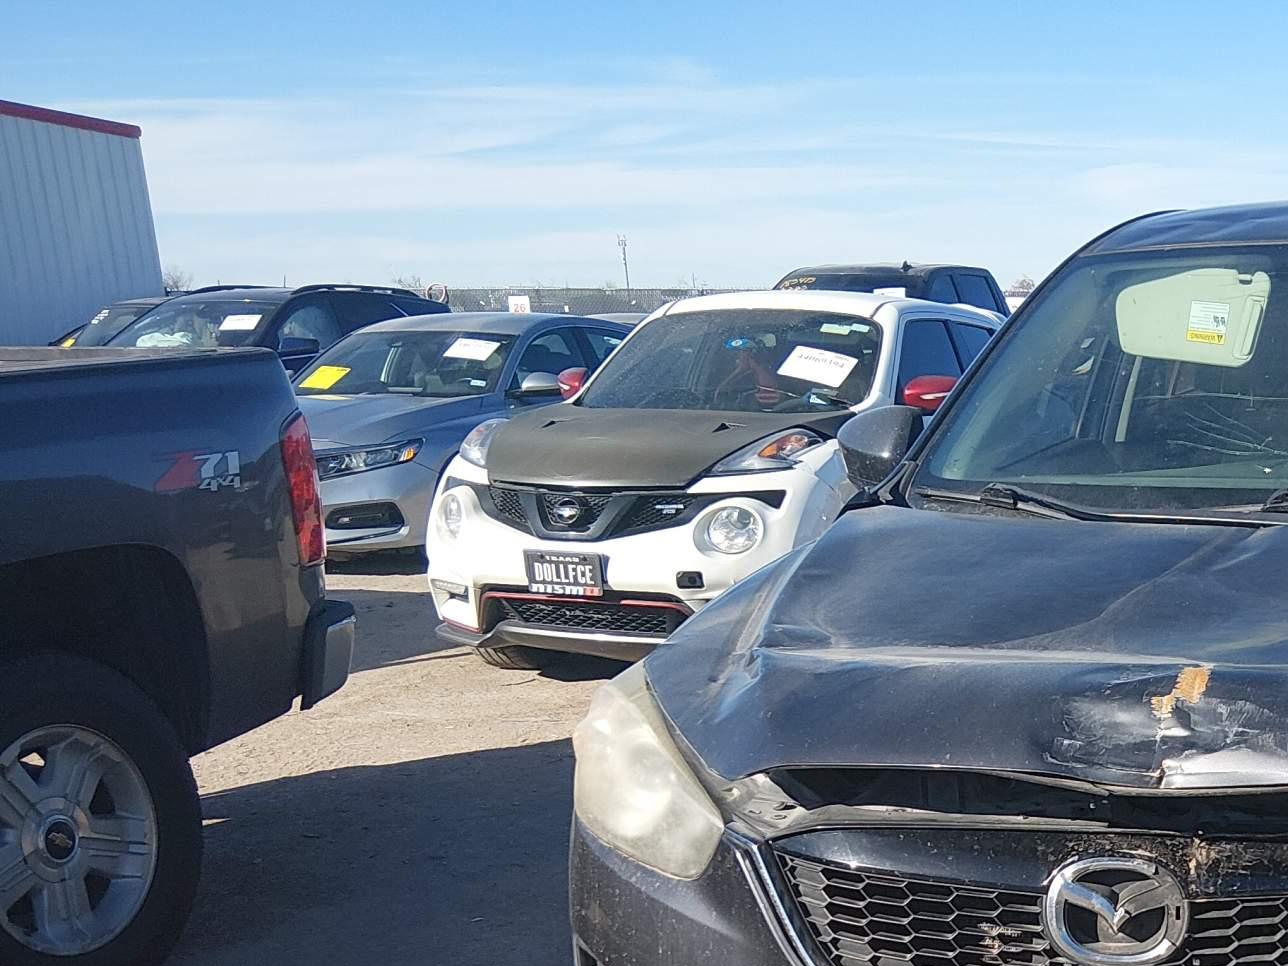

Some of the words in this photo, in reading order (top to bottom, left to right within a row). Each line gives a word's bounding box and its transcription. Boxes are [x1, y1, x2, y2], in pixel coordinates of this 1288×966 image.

[513, 303, 526, 313] 26
[154, 449, 240, 493] Z71
[533, 562, 595, 585] DOLLFCE
